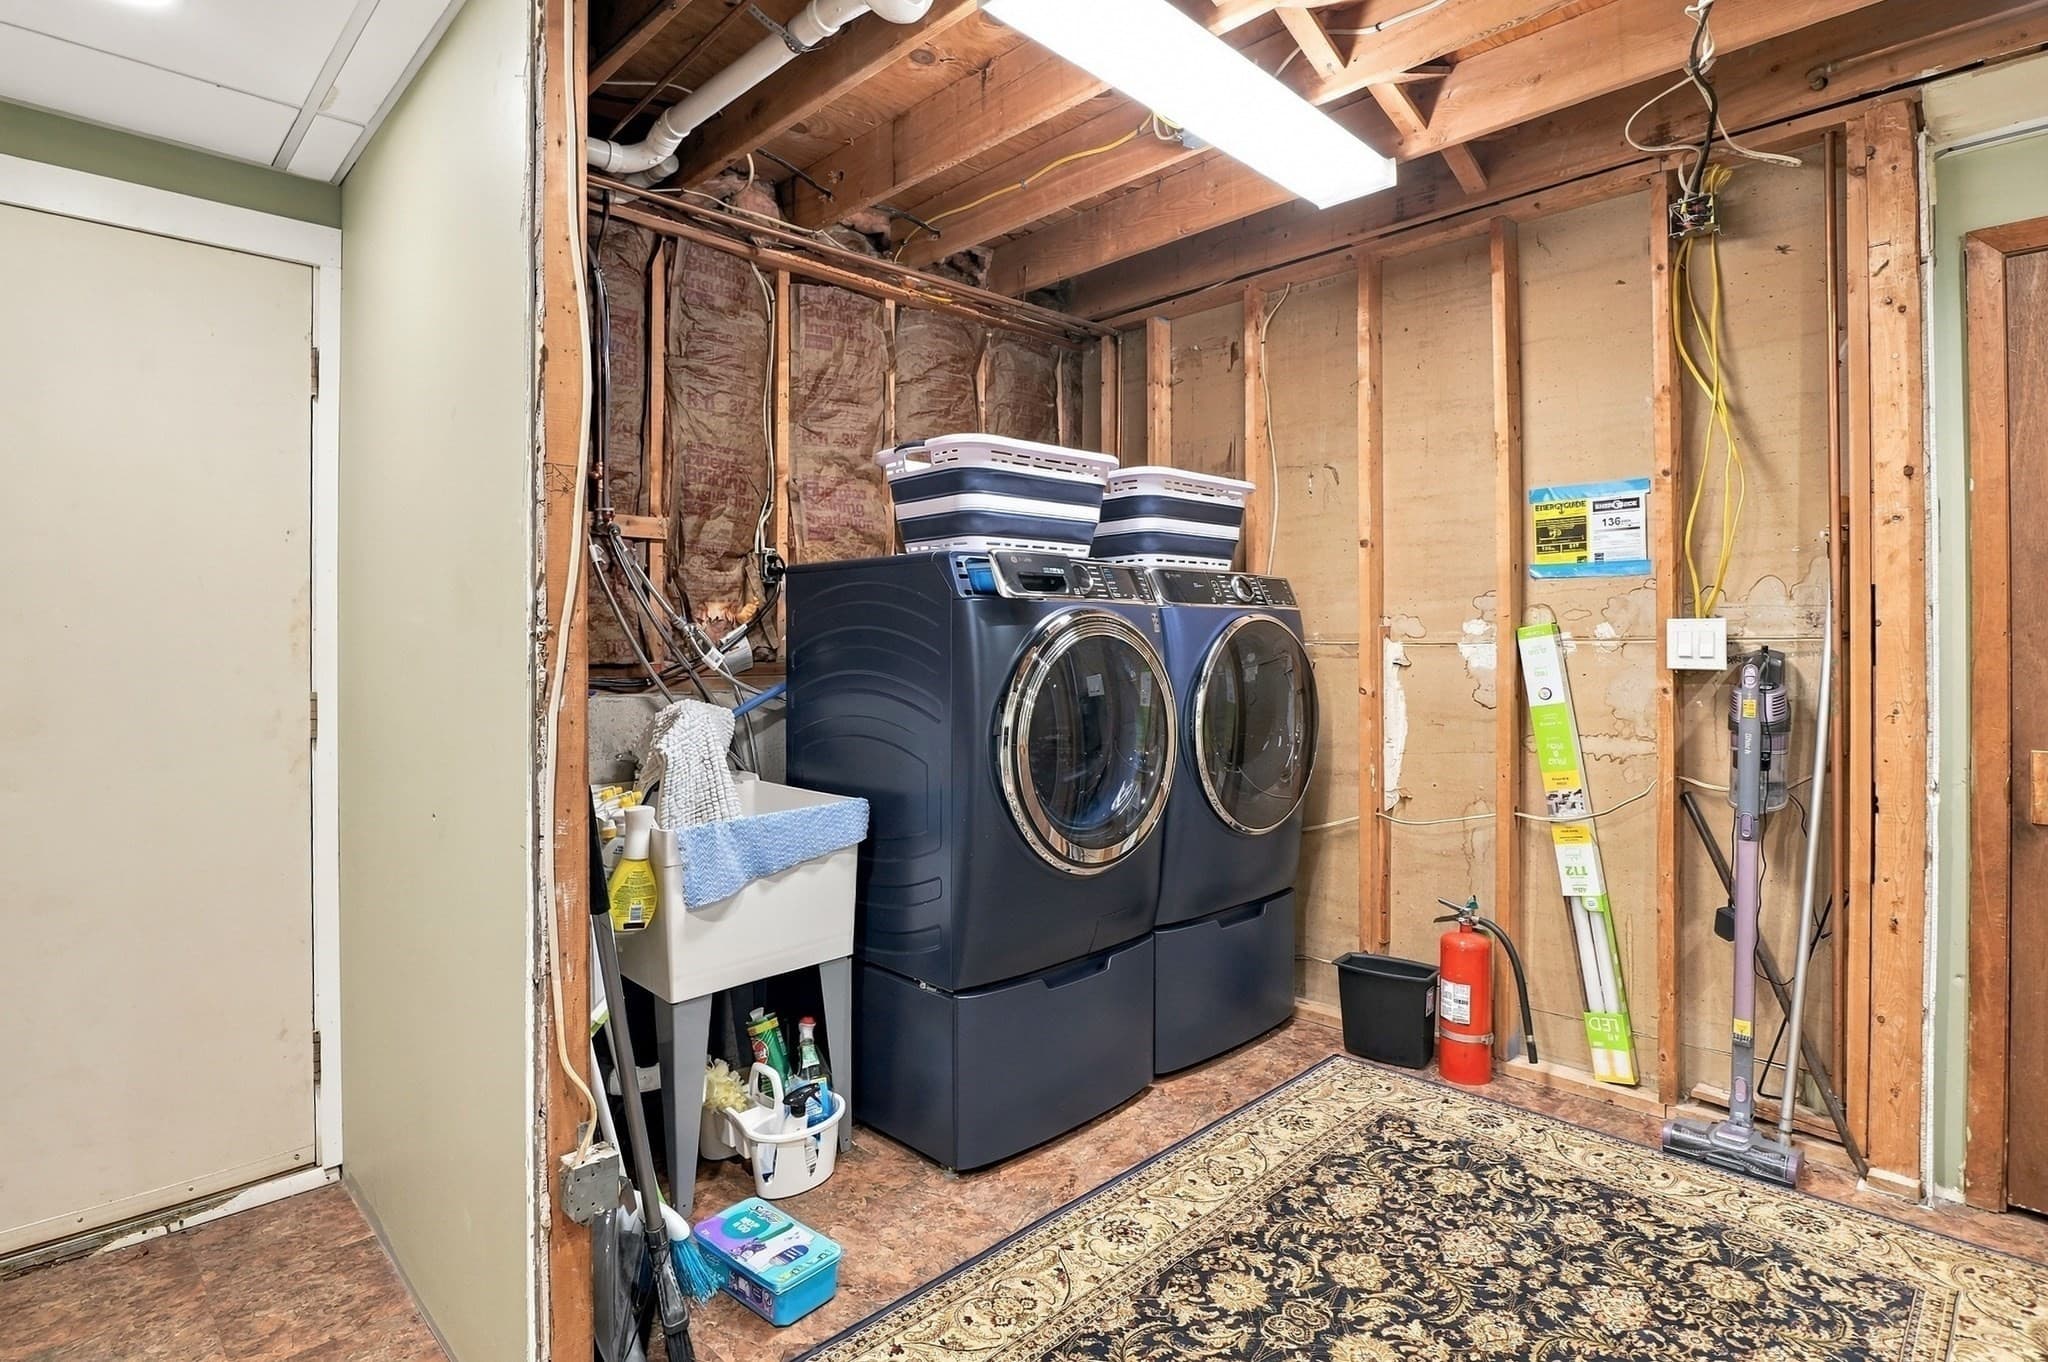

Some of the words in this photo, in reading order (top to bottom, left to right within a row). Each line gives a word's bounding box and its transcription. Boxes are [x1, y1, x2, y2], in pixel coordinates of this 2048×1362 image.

[1602, 516, 1621, 527] 136
[1565, 865, 1588, 877] T12
[1589, 1016, 1621, 1032] LED
